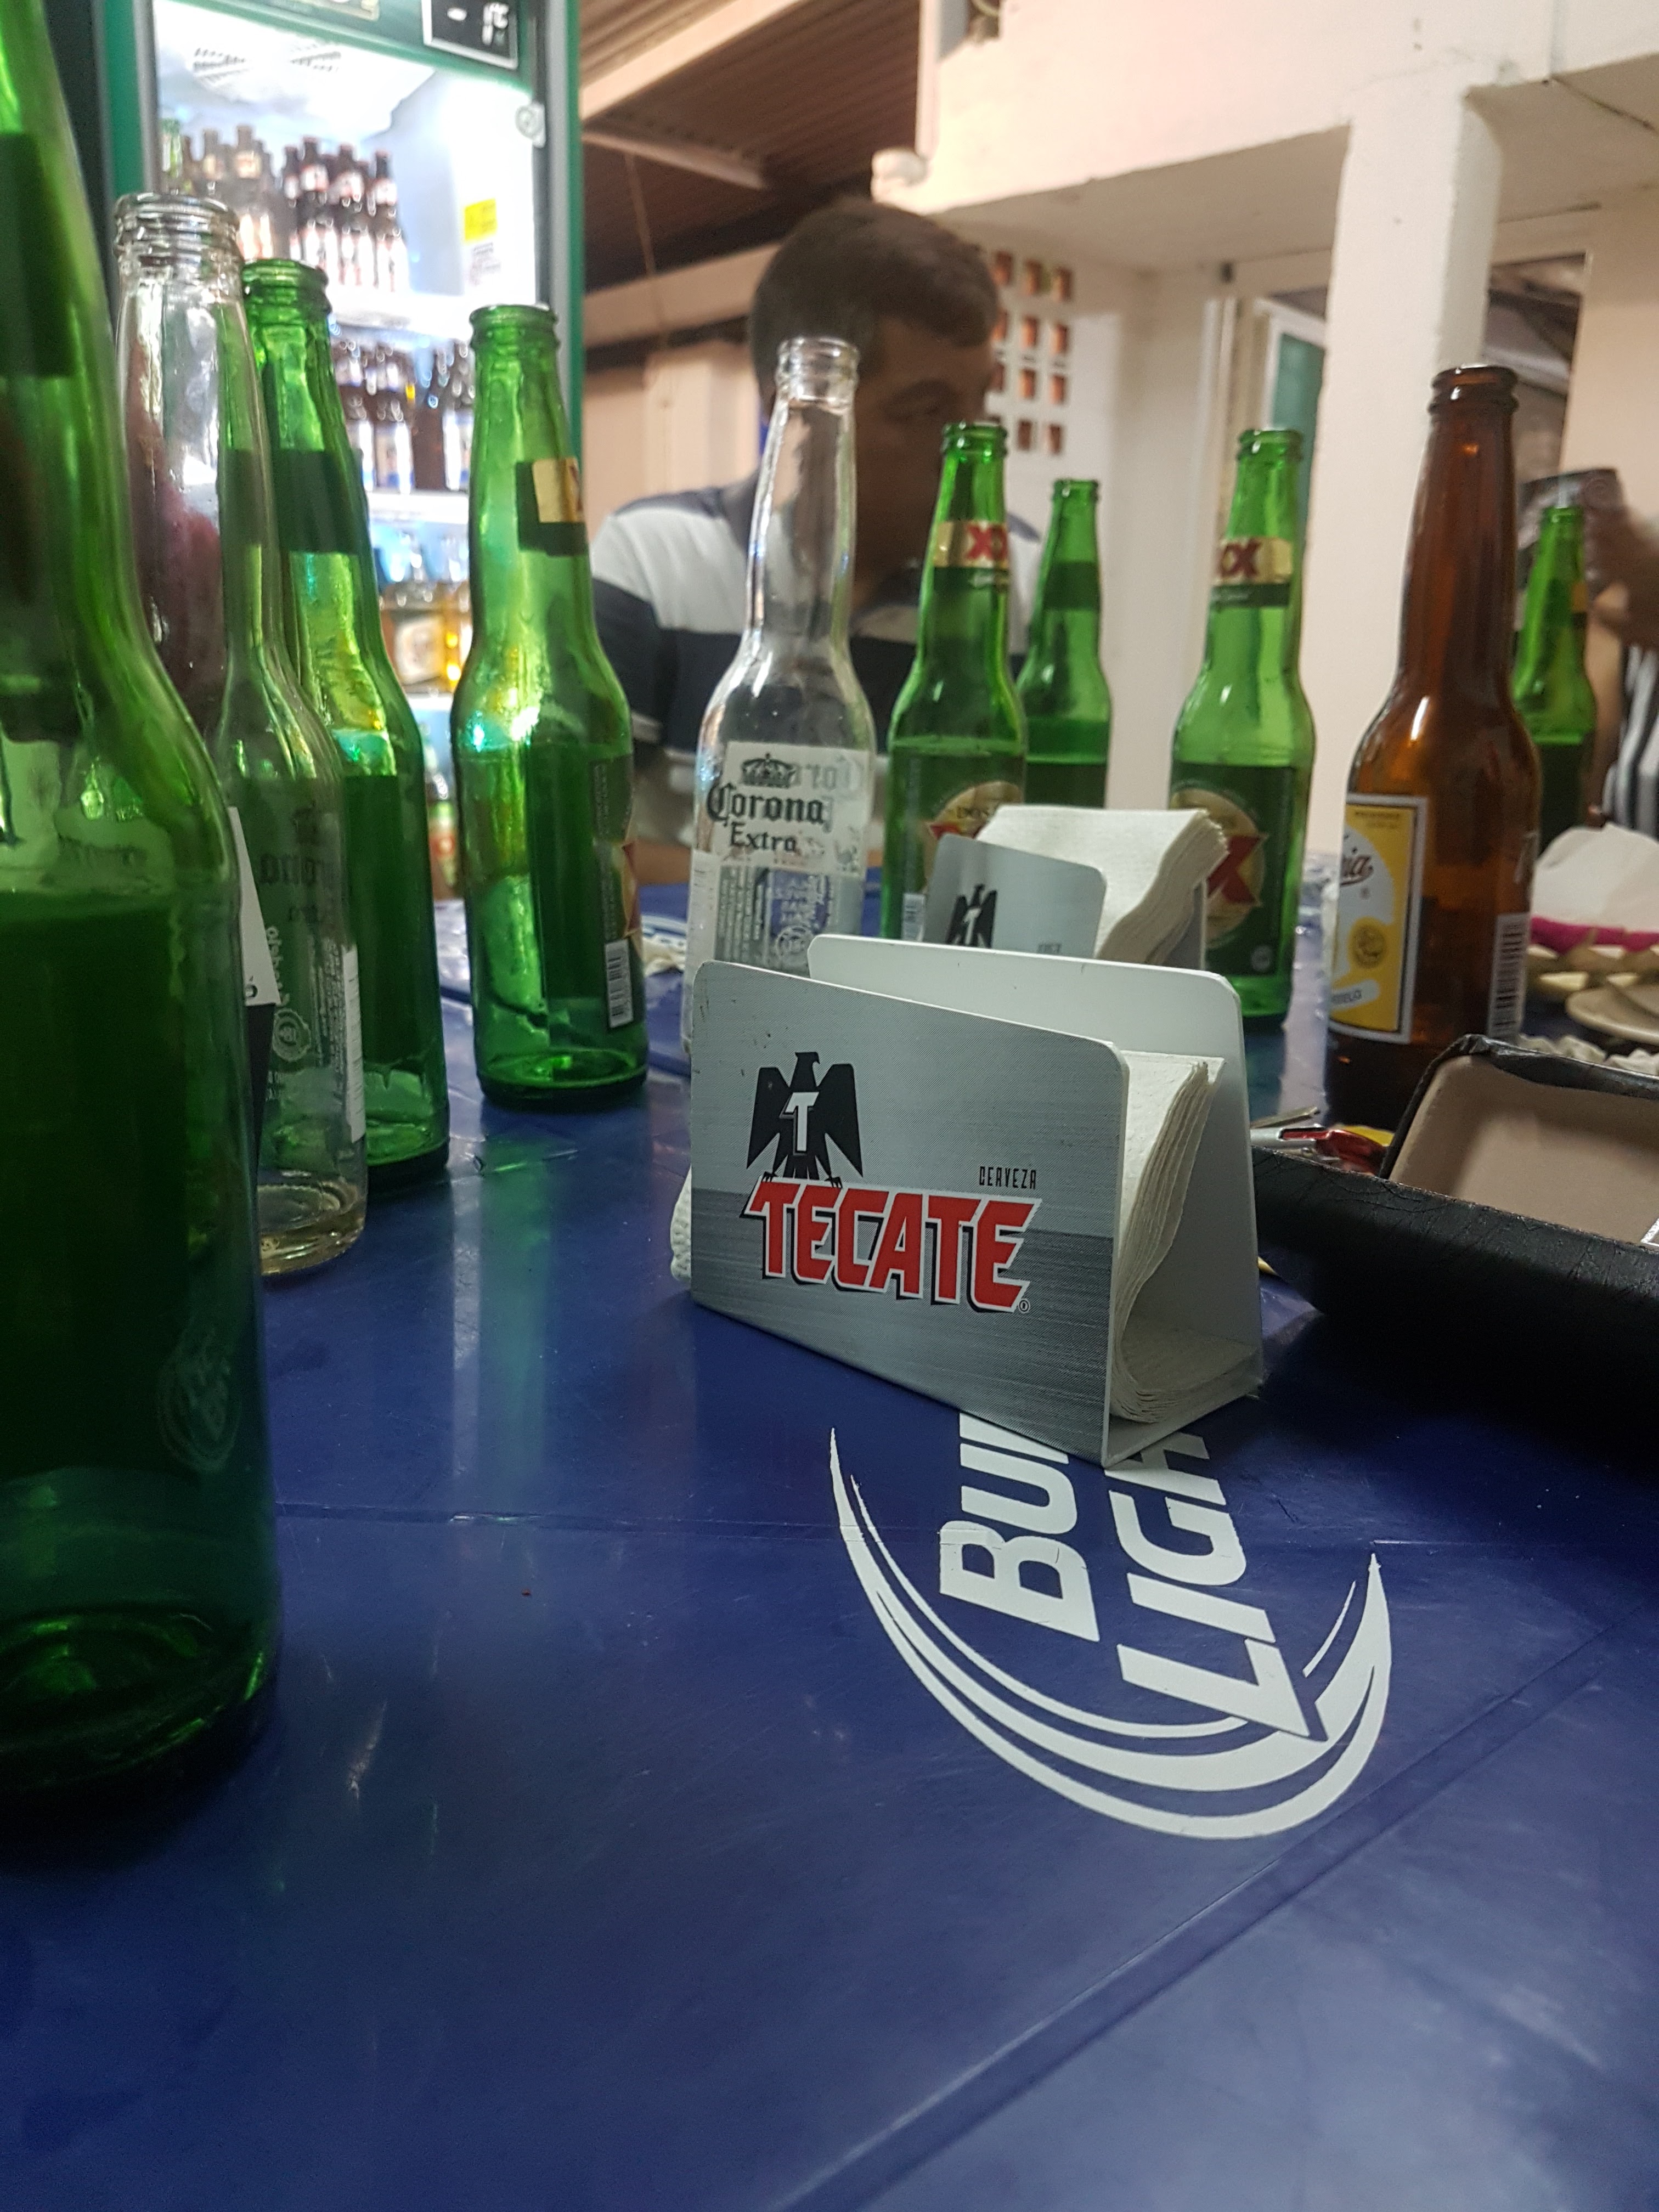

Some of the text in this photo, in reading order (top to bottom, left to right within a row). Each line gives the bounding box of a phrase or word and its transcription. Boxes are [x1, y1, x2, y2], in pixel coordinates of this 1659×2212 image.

[707, 782, 824, 827] Corona
[729, 822, 797, 853] Extra
[979, 1166, 1037, 1189] CERVEZA
[741, 1177, 1041, 1313] TECATE
